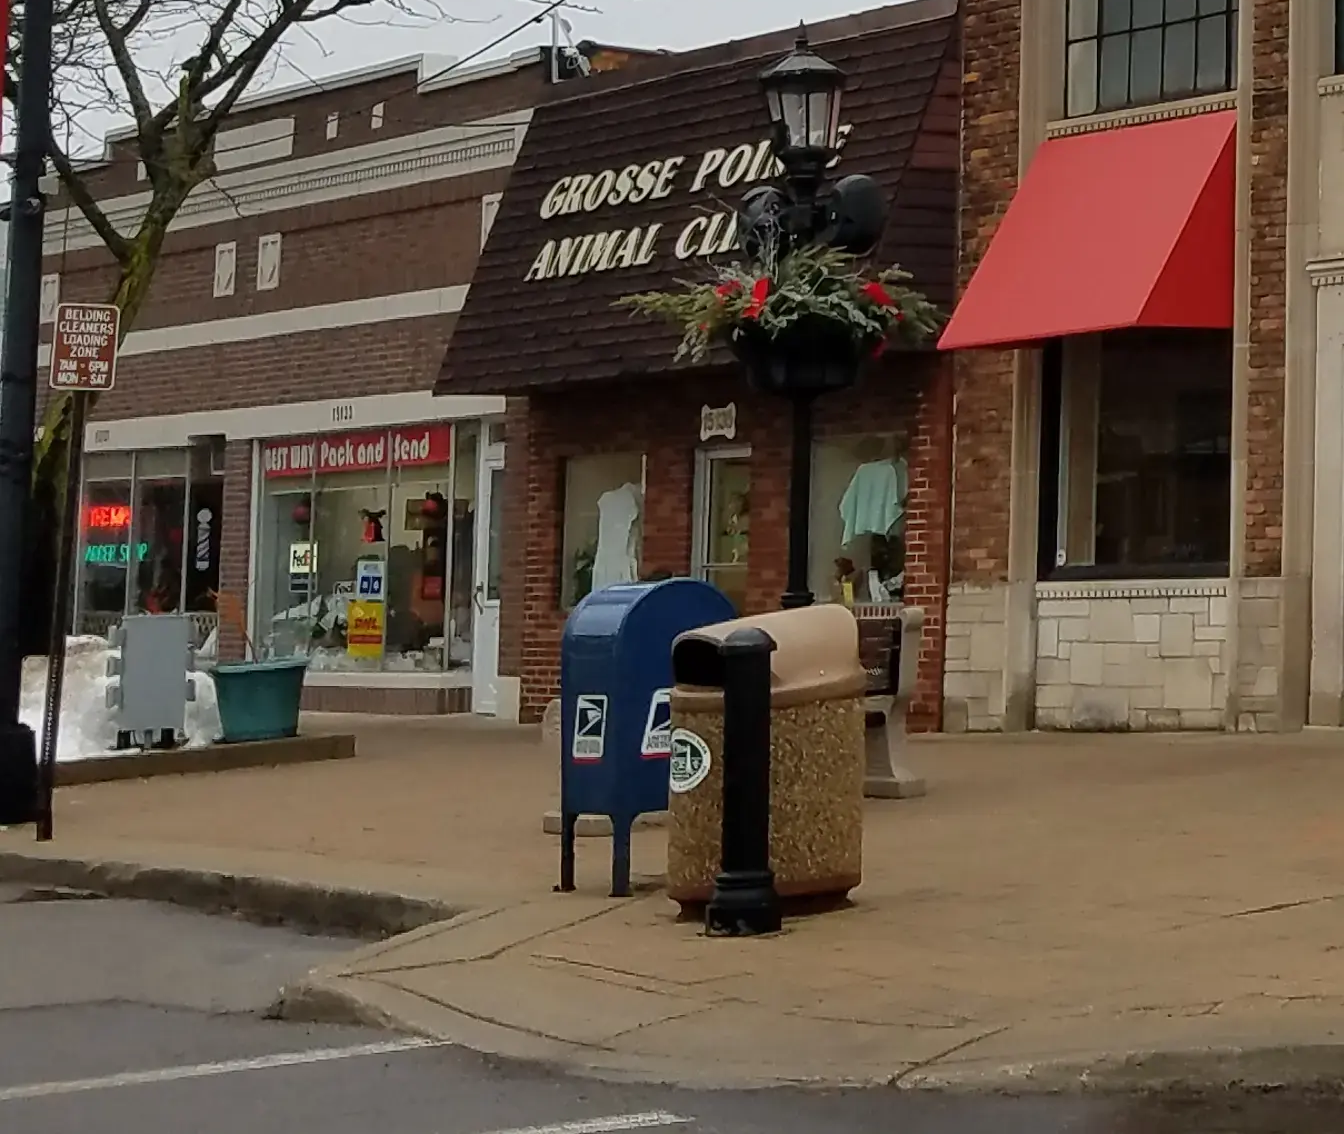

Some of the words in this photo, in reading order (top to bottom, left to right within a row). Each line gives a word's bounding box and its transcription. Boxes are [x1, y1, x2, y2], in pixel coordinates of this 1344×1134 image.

[540, 156, 686, 219] GROSSE
[523, 223, 664, 282] ANIMAL
[675, 211, 740, 260] CLI
[65, 308, 111, 322] BELDING
[60, 321, 115, 336] CLEANERS
[64, 334, 108, 346] LOADING
[70, 346, 100, 358] ZONE
[59, 359, 77, 370] 7AM
[58, 372, 79, 384] MON
[90, 373, 107, 385] SAT
[265, 447, 288, 471] BEST
[291, 443, 316, 469] WAY
[321, 439, 354, 468] Pack
[357, 436, 385, 464] and
[394, 431, 430, 461] Send
